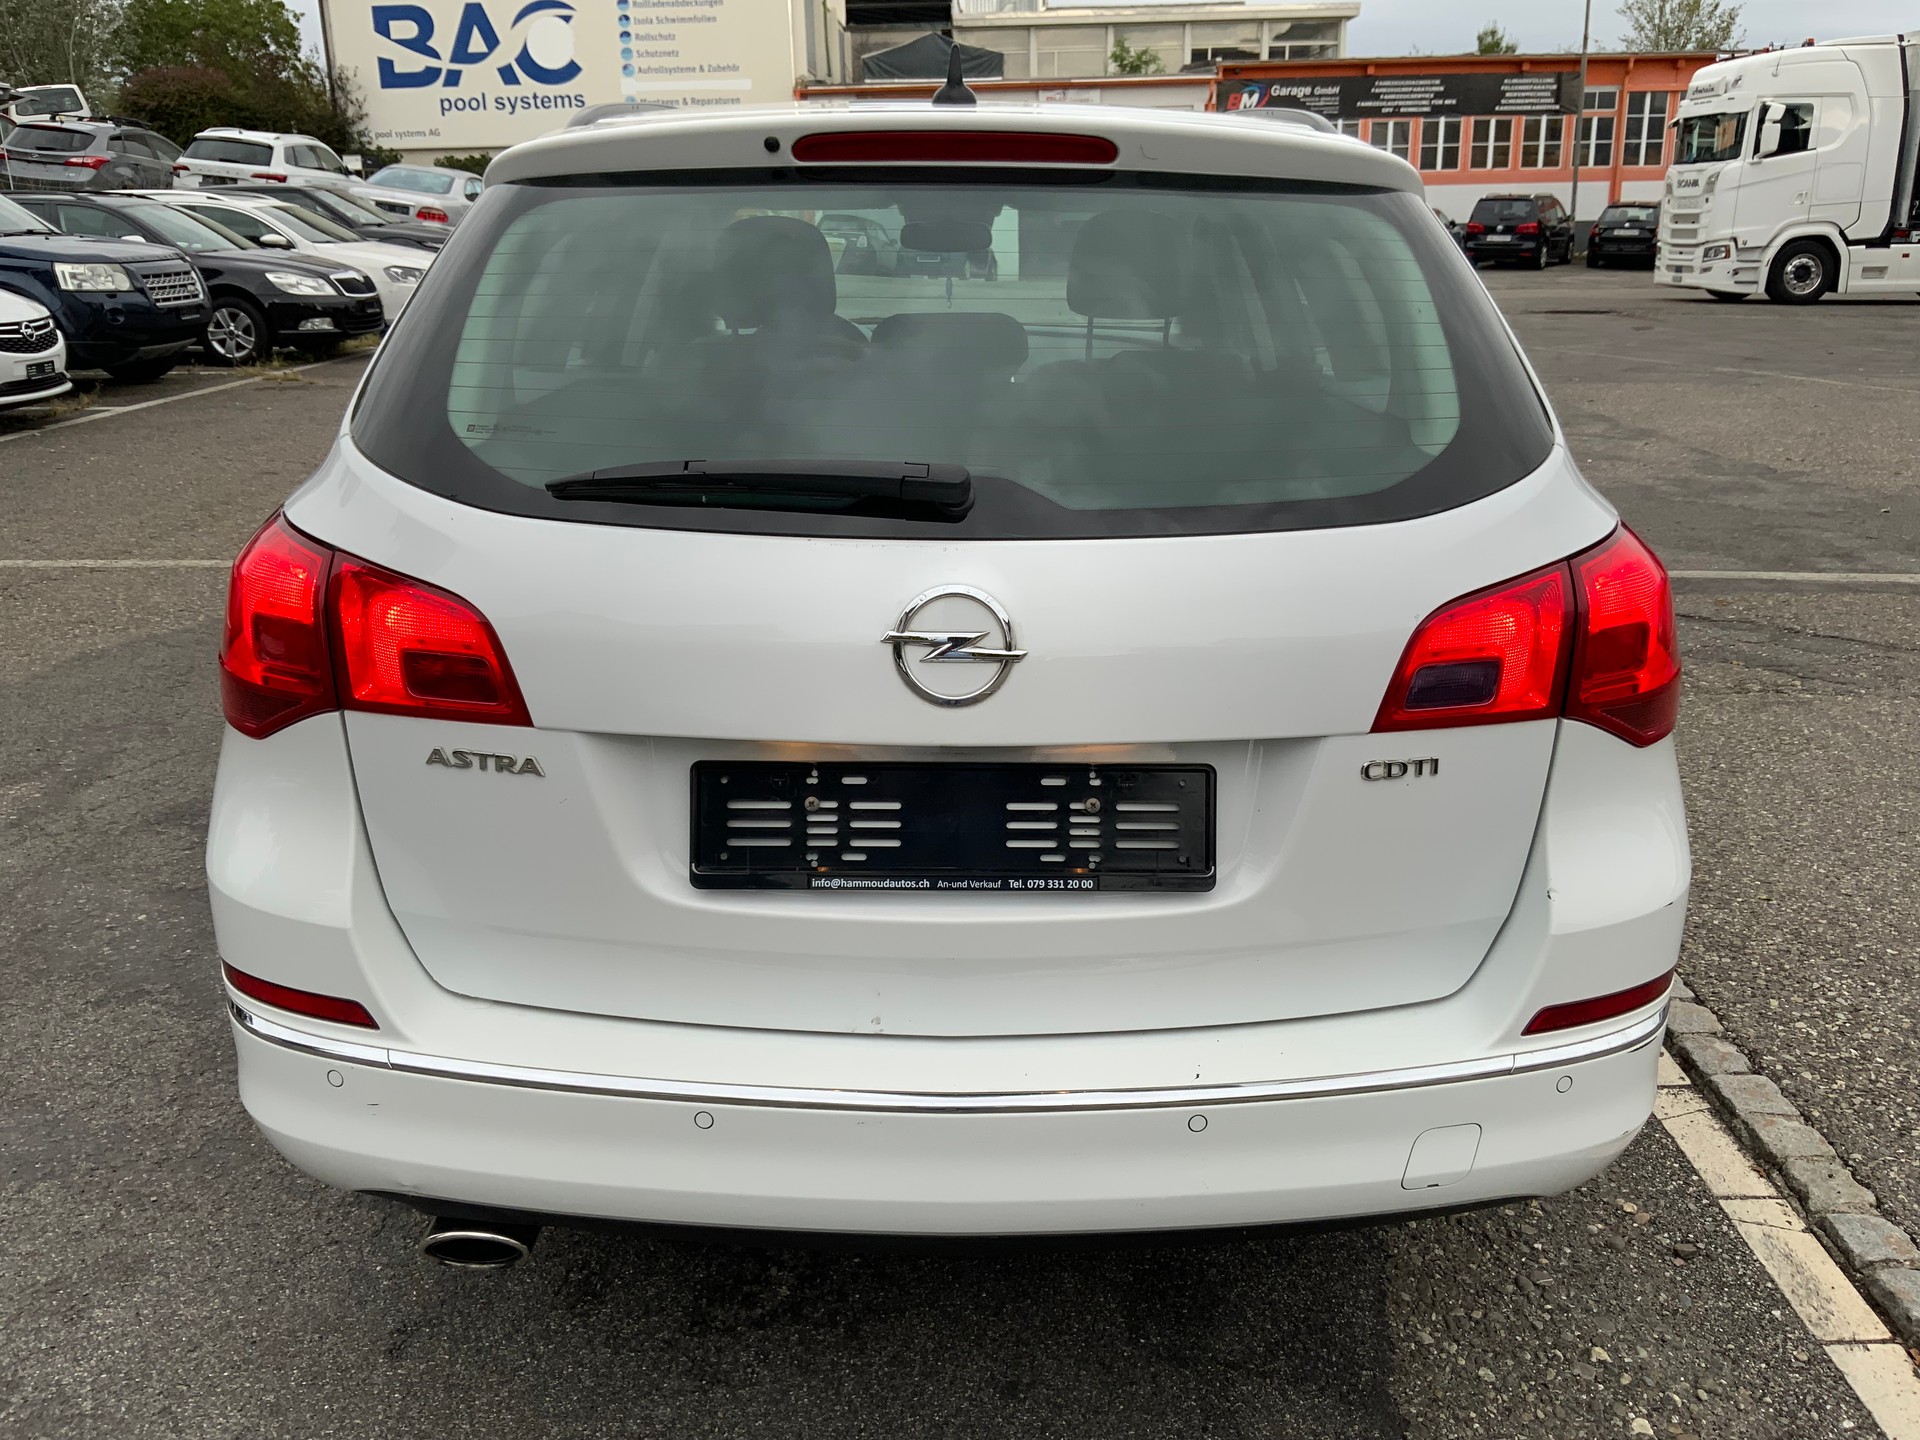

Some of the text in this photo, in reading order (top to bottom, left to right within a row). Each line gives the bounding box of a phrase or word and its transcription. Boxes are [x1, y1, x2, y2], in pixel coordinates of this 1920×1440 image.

[655, 15, 717, 24] Schwimmfolien
[634, 33, 676, 41] Rollschutz
[371, 0, 583, 89] BAC
[636, 50, 679, 58] Schutznetz
[638, 64, 740, 75] Aufrollsysteme & Zubehör
[1270, 84, 1340, 98] Garage GmbH
[440, 92, 586, 116] pool systems
[682, 97, 688, 106] &
[690, 97, 740, 107] Reparaturen
[375, 128, 392, 140] pool
[394, 129, 427, 141] systems
[429, 128, 441, 137] AG
[1677, 178, 1700, 188] SCANIA
[426, 746, 546, 777] ASTRA
[1360, 757, 1439, 781] CDTI
[812, 879, 1093, 889] info@hammoudautos.ch An-und Verkauf Tel. 079 331 20 00
